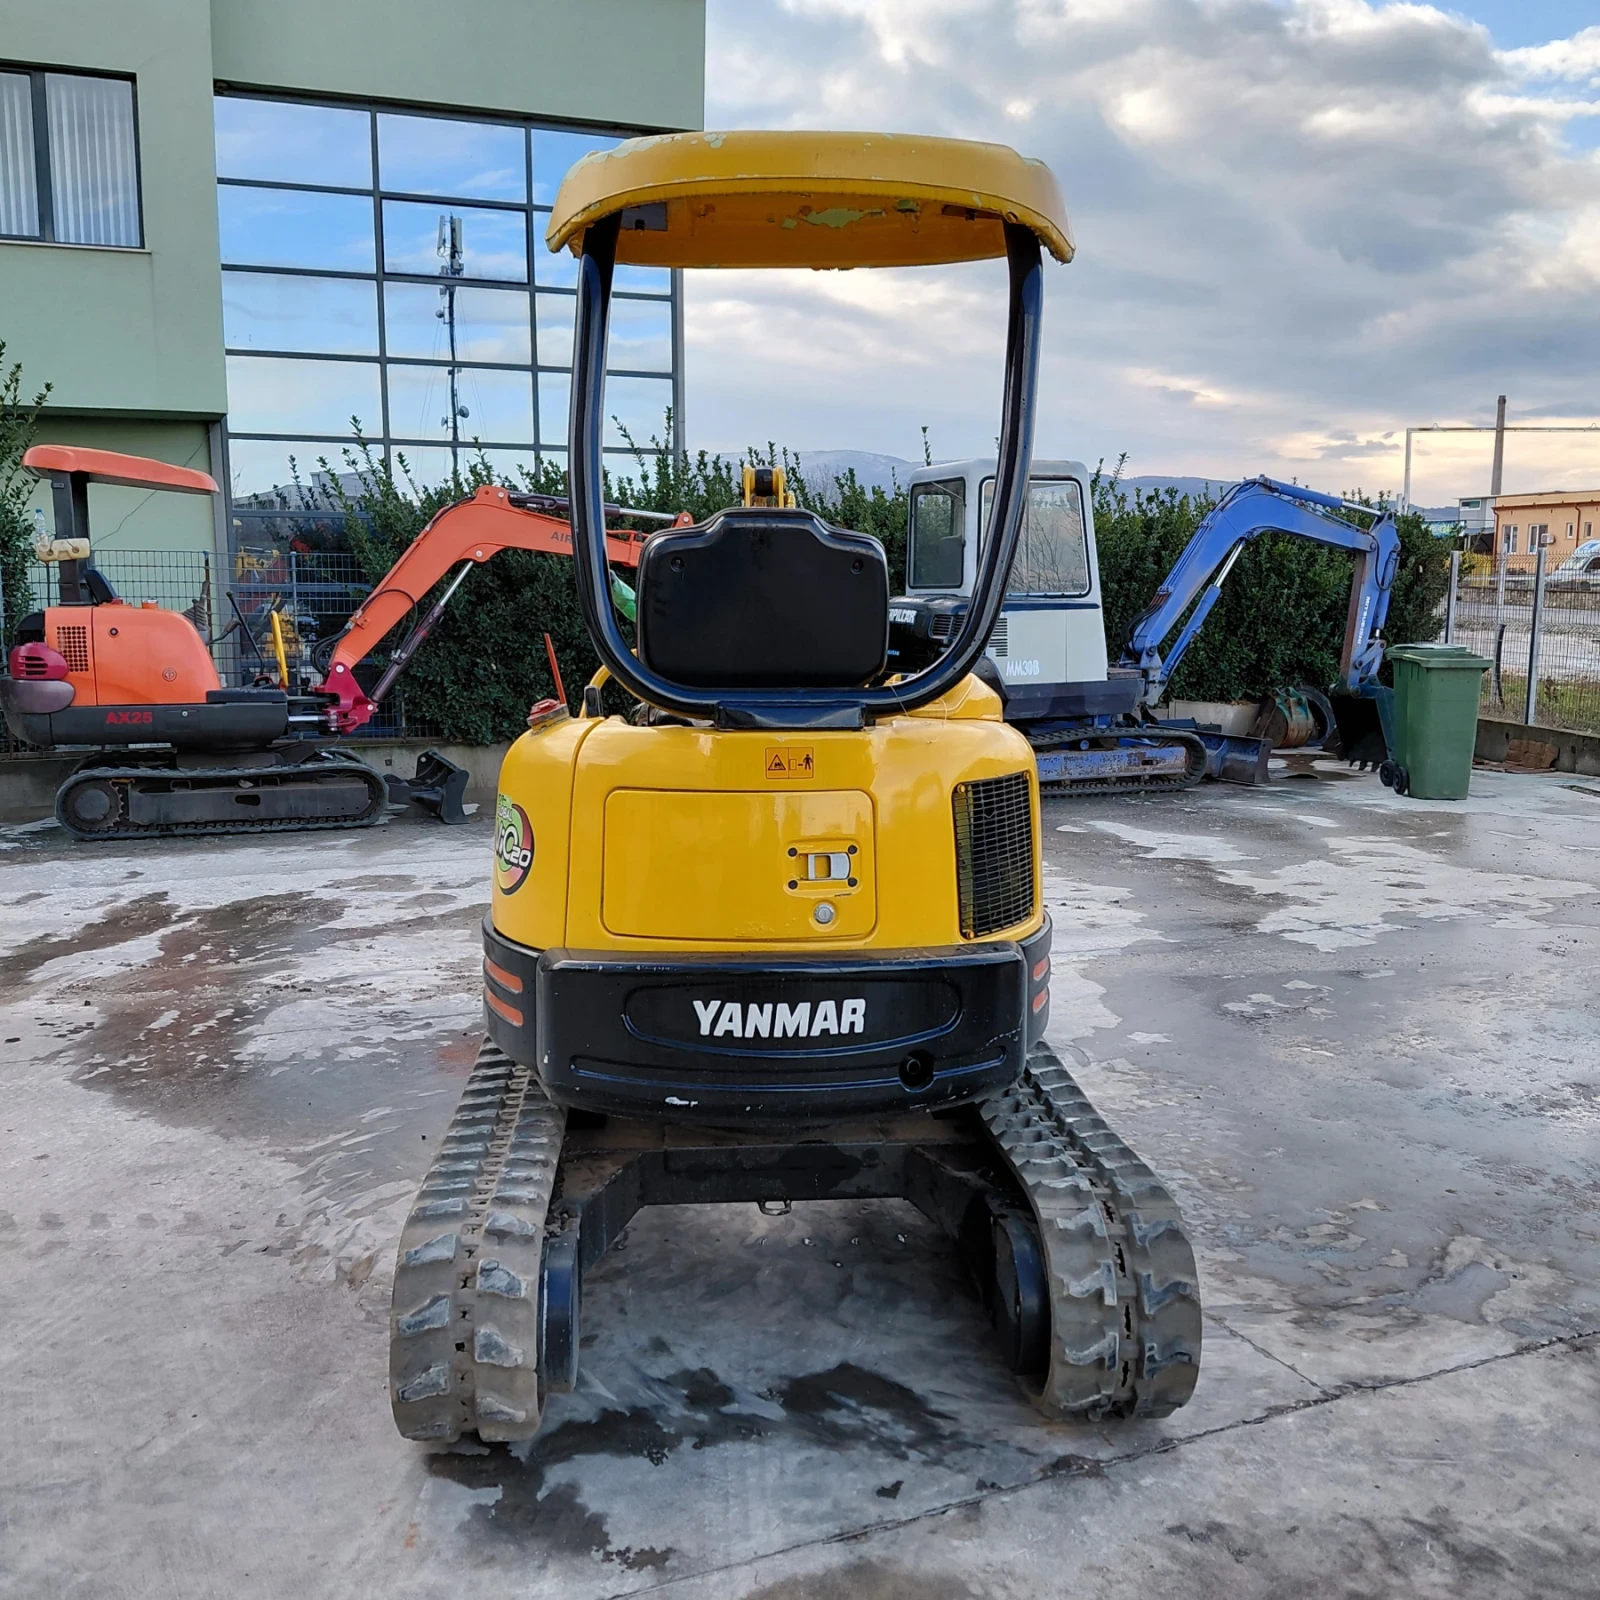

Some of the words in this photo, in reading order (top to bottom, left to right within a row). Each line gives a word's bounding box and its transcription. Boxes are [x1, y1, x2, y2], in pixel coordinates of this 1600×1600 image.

[1006, 659, 1040, 677] MM30B
[105, 711, 153, 725] AX25
[692, 998, 866, 1038] YANMAR
